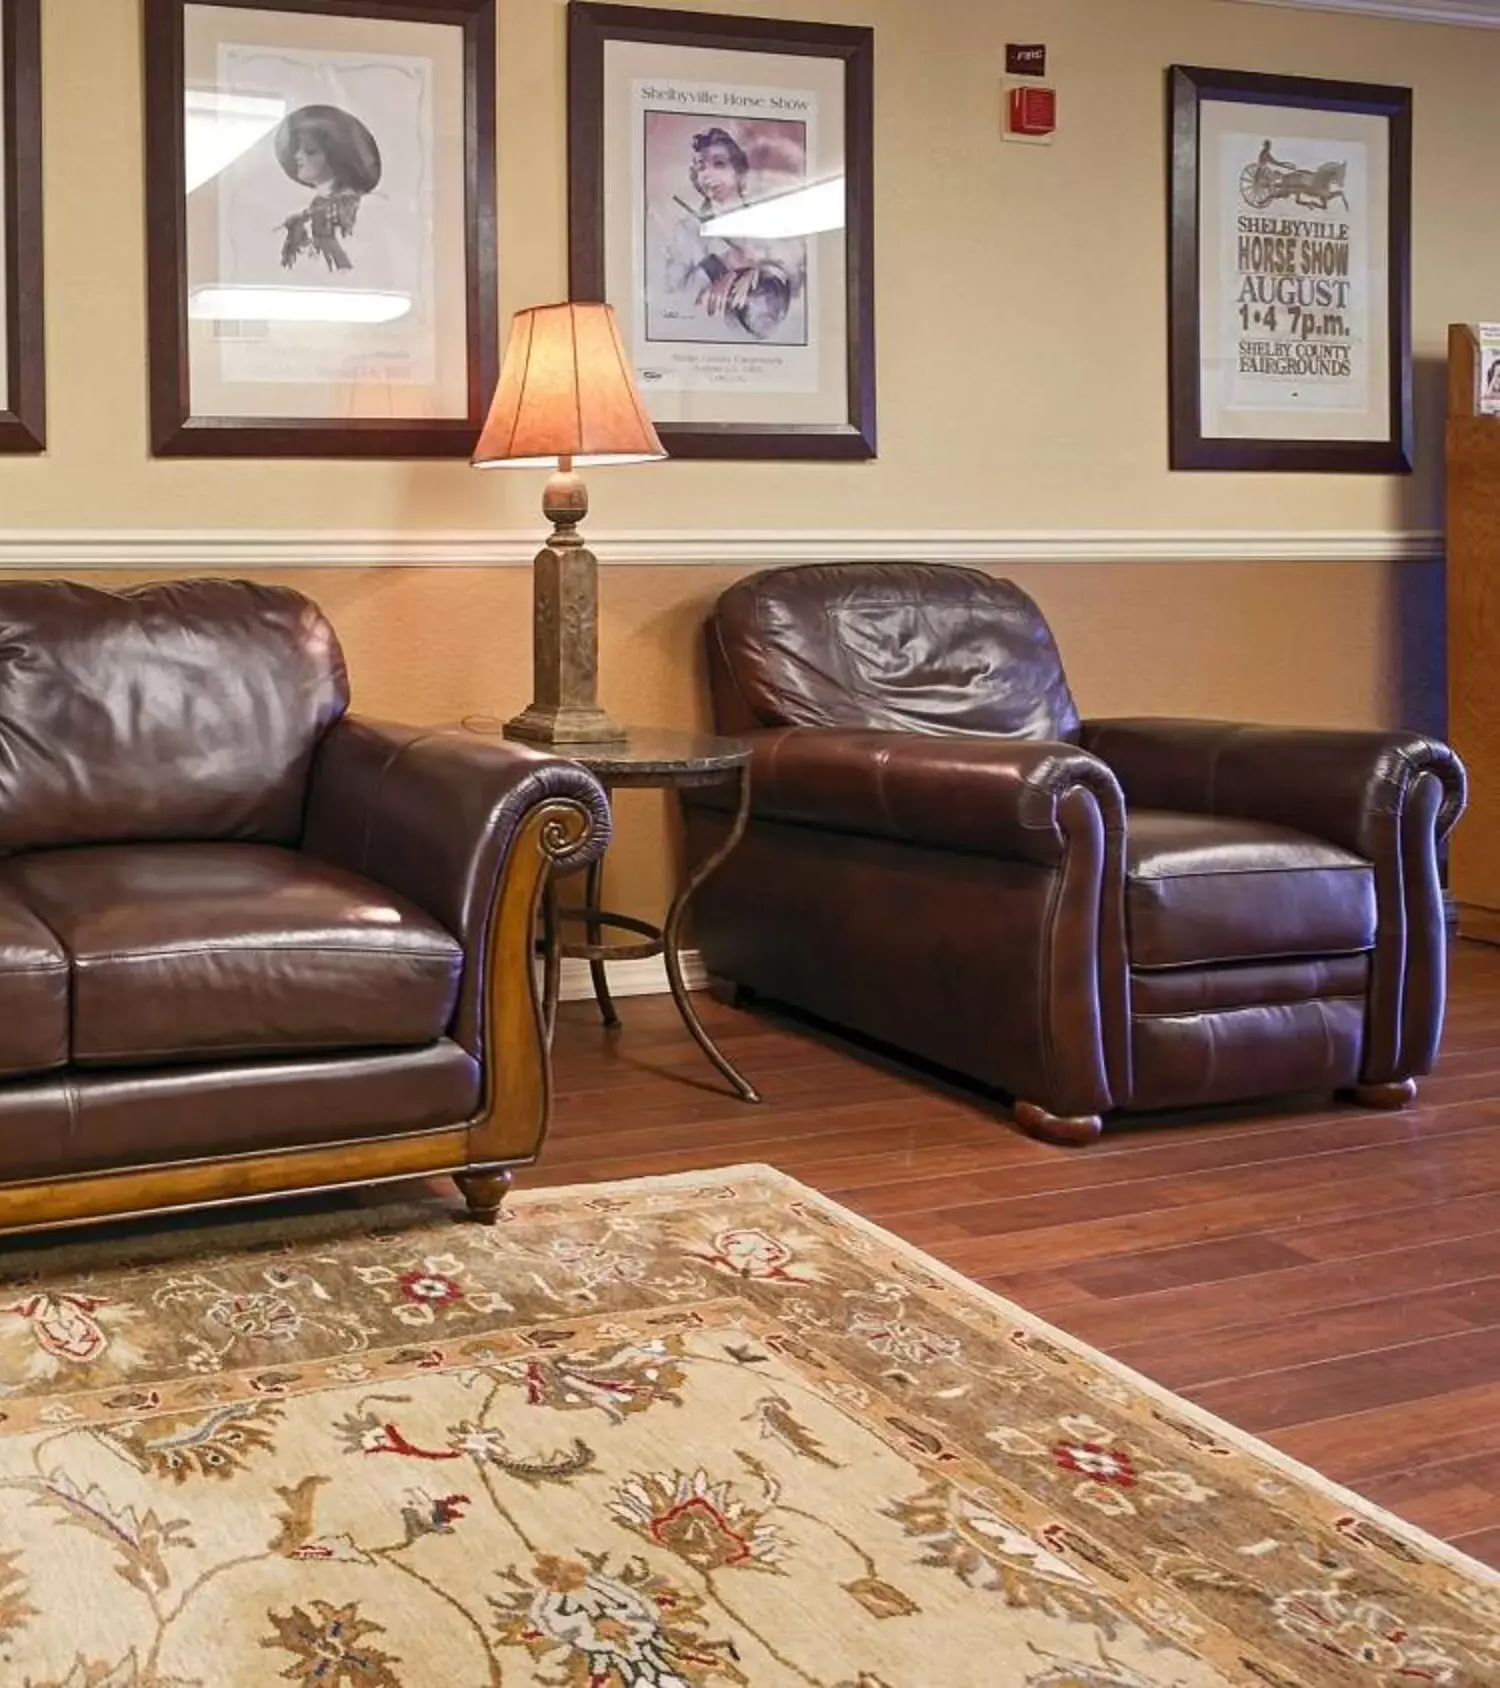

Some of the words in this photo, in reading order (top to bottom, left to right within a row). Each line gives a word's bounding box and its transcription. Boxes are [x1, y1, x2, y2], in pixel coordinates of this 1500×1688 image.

[641, 86, 718, 104] Shelbyville
[723, 93, 765, 107] Horse
[770, 96, 808, 110] Show
[1238, 216, 1349, 240] SHELBYVILLE
[1238, 236, 1296, 273] HORSE
[1300, 240, 1348, 276] SHOW
[1237, 275, 1350, 308] AUGUST
[1288, 306, 1350, 340] 7p.m.
[1239, 340, 1291, 356] SHELBY
[1295, 343, 1350, 358] COUNTY
[1240, 357, 1350, 376] FAIRGROUNDS
